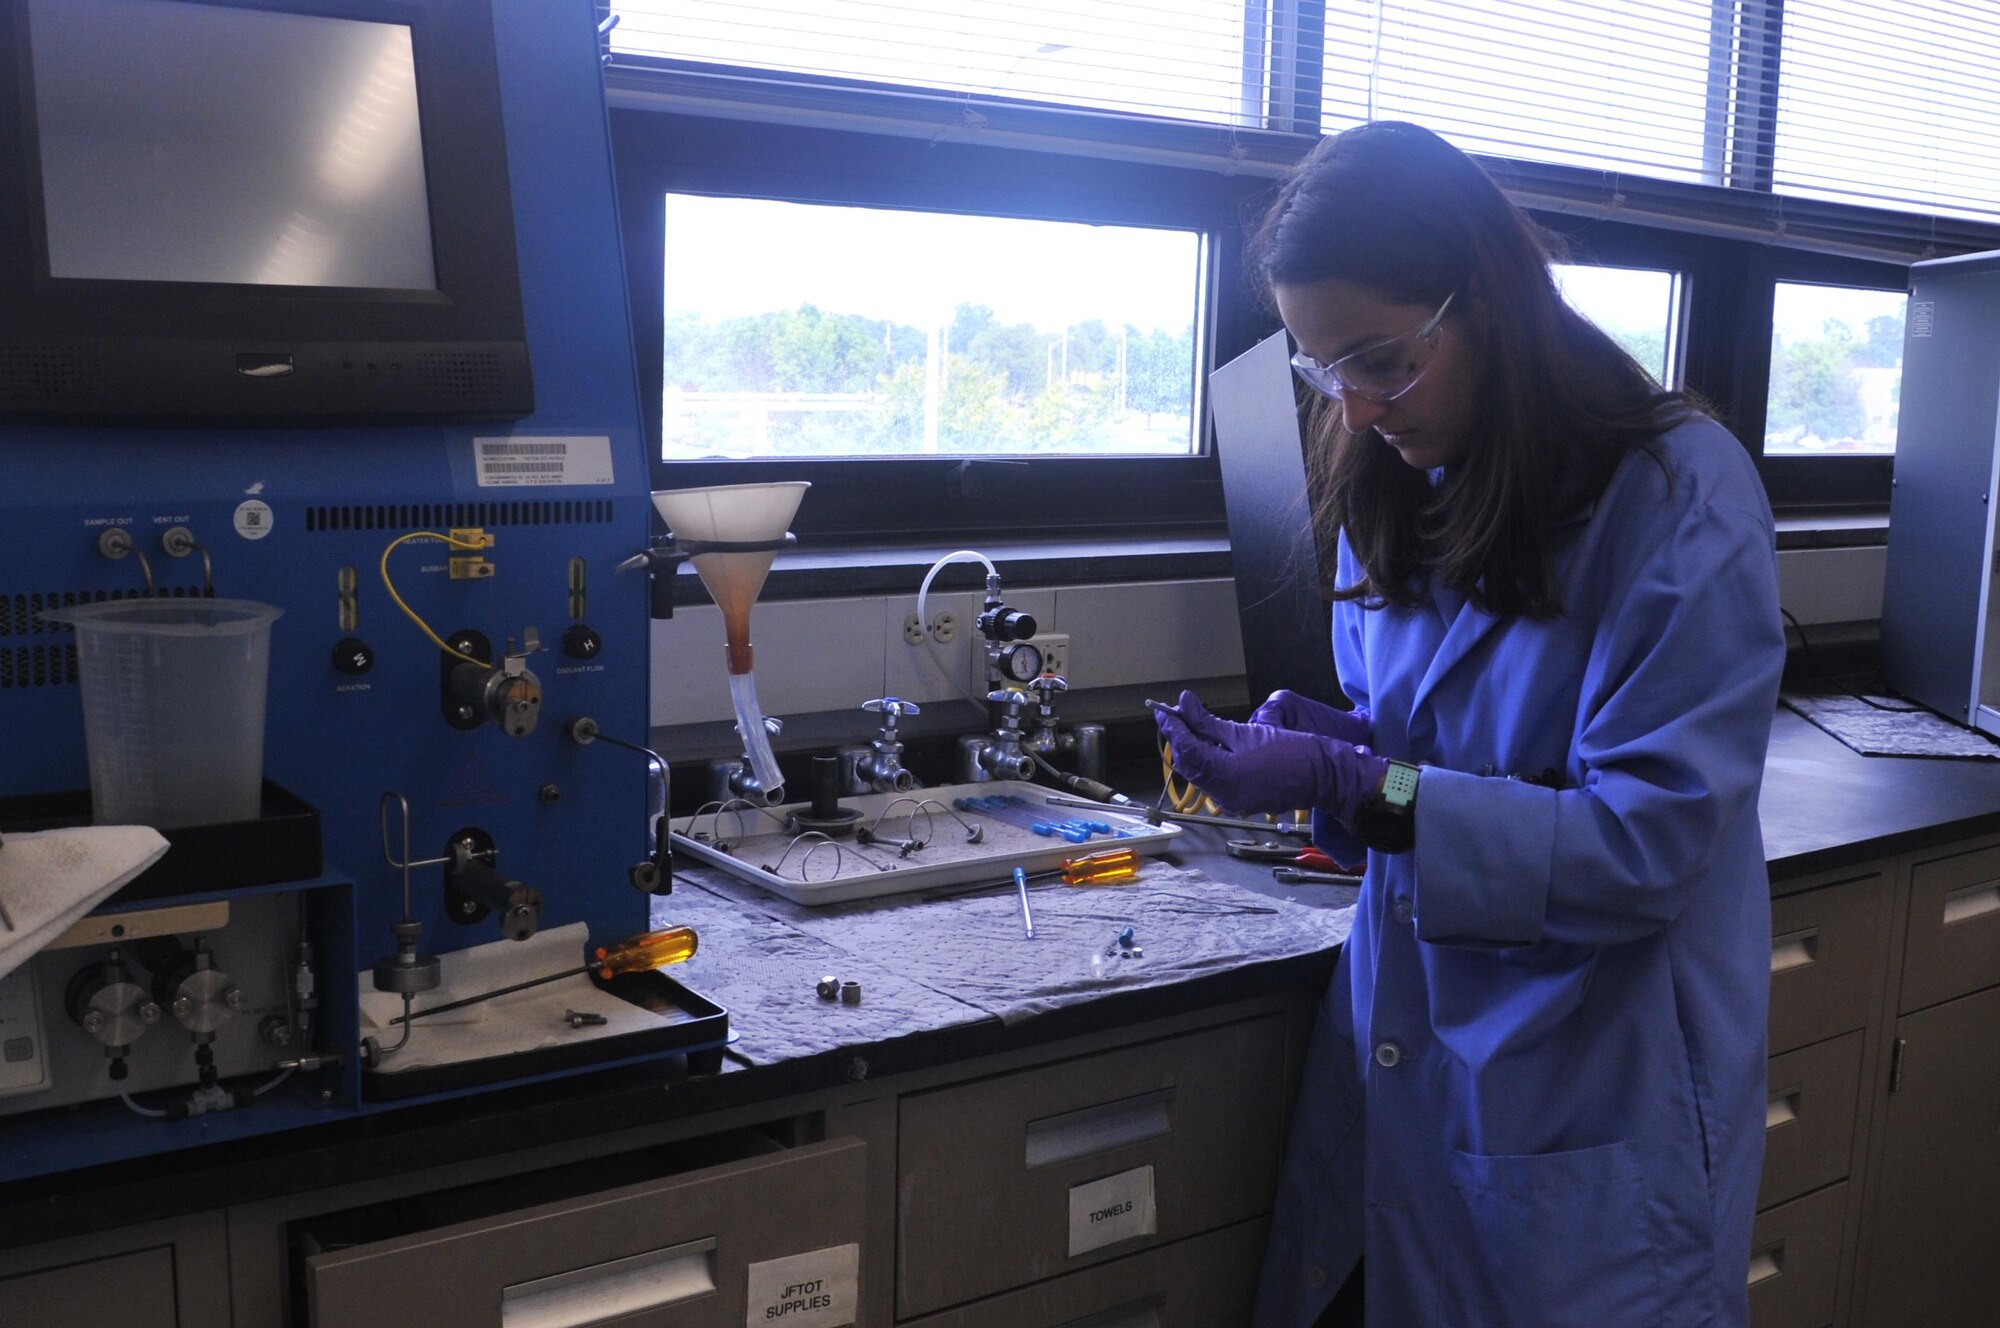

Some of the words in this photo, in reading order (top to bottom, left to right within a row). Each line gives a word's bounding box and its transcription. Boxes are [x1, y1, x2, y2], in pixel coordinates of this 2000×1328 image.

[84, 518, 114, 527] SAMPLE
[117, 517, 133, 526] OUT
[174, 515, 190, 523] OUT
[584, 638, 594, 651] H
[556, 666, 585, 674] COOLANT
[1089, 1201, 1133, 1223] TOWELS
[781, 1280, 823, 1299] JFTOT
[766, 1294, 831, 1319] SUPPLIES
